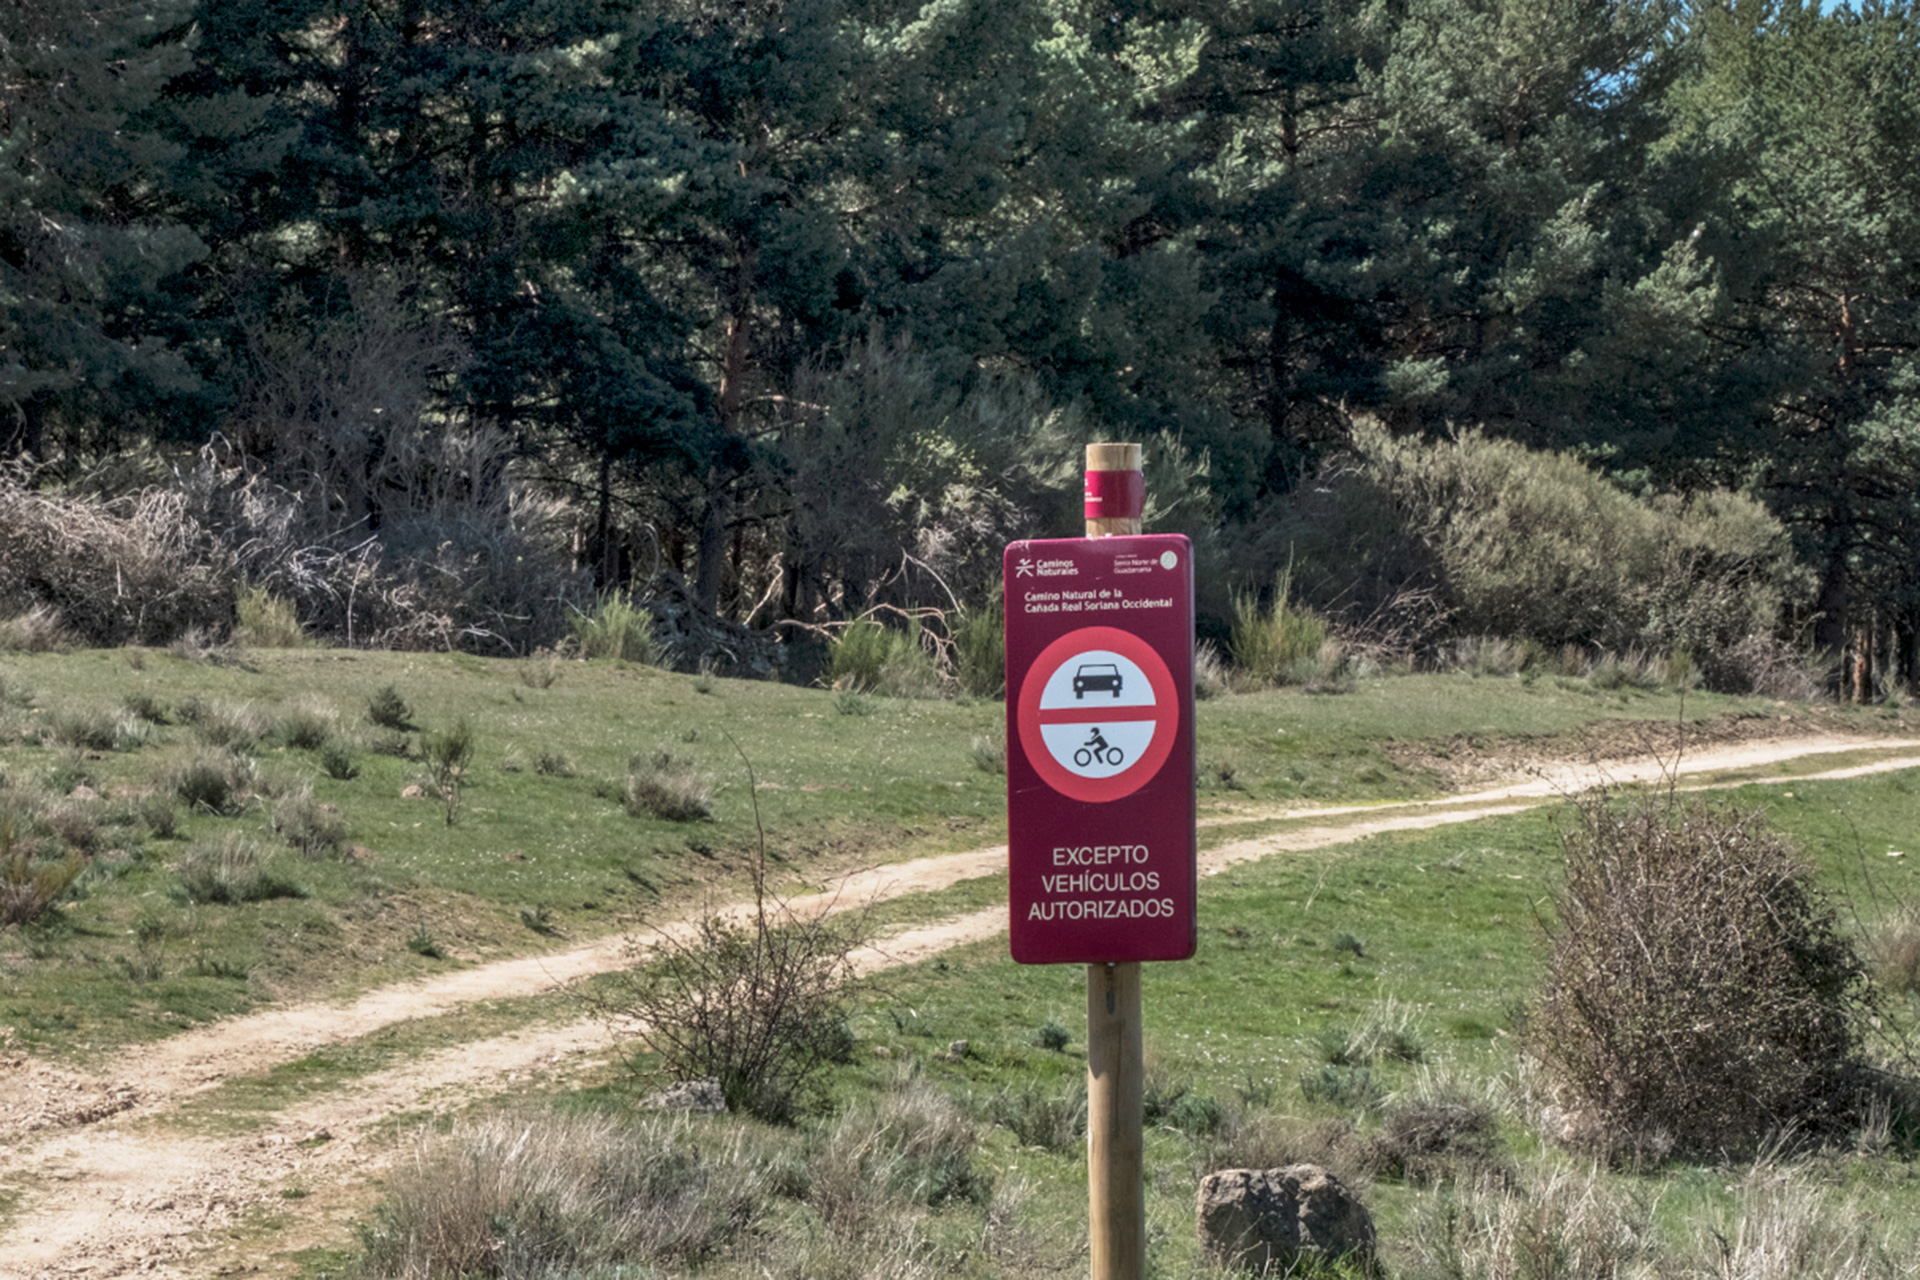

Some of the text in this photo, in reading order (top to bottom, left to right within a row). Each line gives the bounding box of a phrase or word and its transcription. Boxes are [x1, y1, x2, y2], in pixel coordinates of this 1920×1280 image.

[1036, 558, 1074, 569] Caminos
[1036, 567, 1079, 577] Naturales
[1024, 588, 1122, 602] Camino Natural de la
[1024, 597, 1173, 613] Cañada Real Soriana Occidental
[1052, 844, 1149, 866] EXCEPTO
[1041, 869, 1160, 893] VEHÍCULOS
[1027, 898, 1175, 921] AUTORIZADOS
